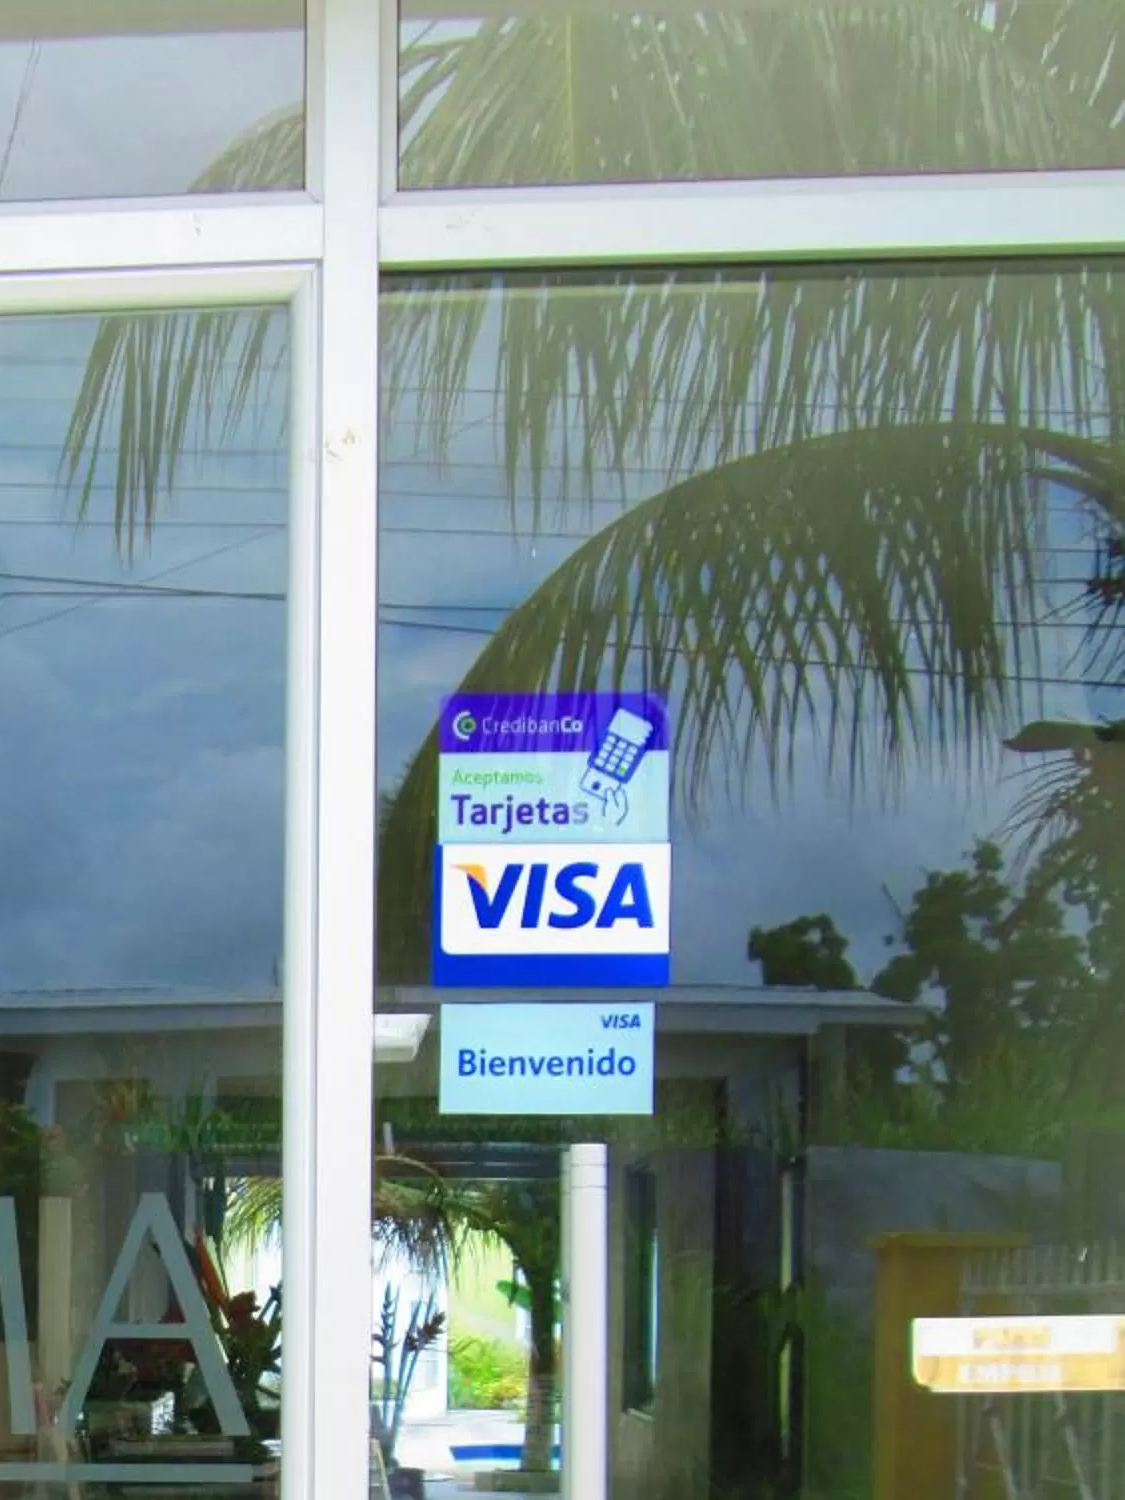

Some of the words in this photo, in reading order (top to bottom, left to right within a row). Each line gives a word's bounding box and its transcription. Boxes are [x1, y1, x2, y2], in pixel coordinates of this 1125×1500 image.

[482, 716, 584, 734] CredibanCo
[452, 767, 544, 790] Aceptamos
[450, 794, 589, 834] Tarjetas
[451, 862, 654, 930] VISA
[600, 1013, 641, 1030] VISA
[457, 1048, 636, 1078] Bienvenido
